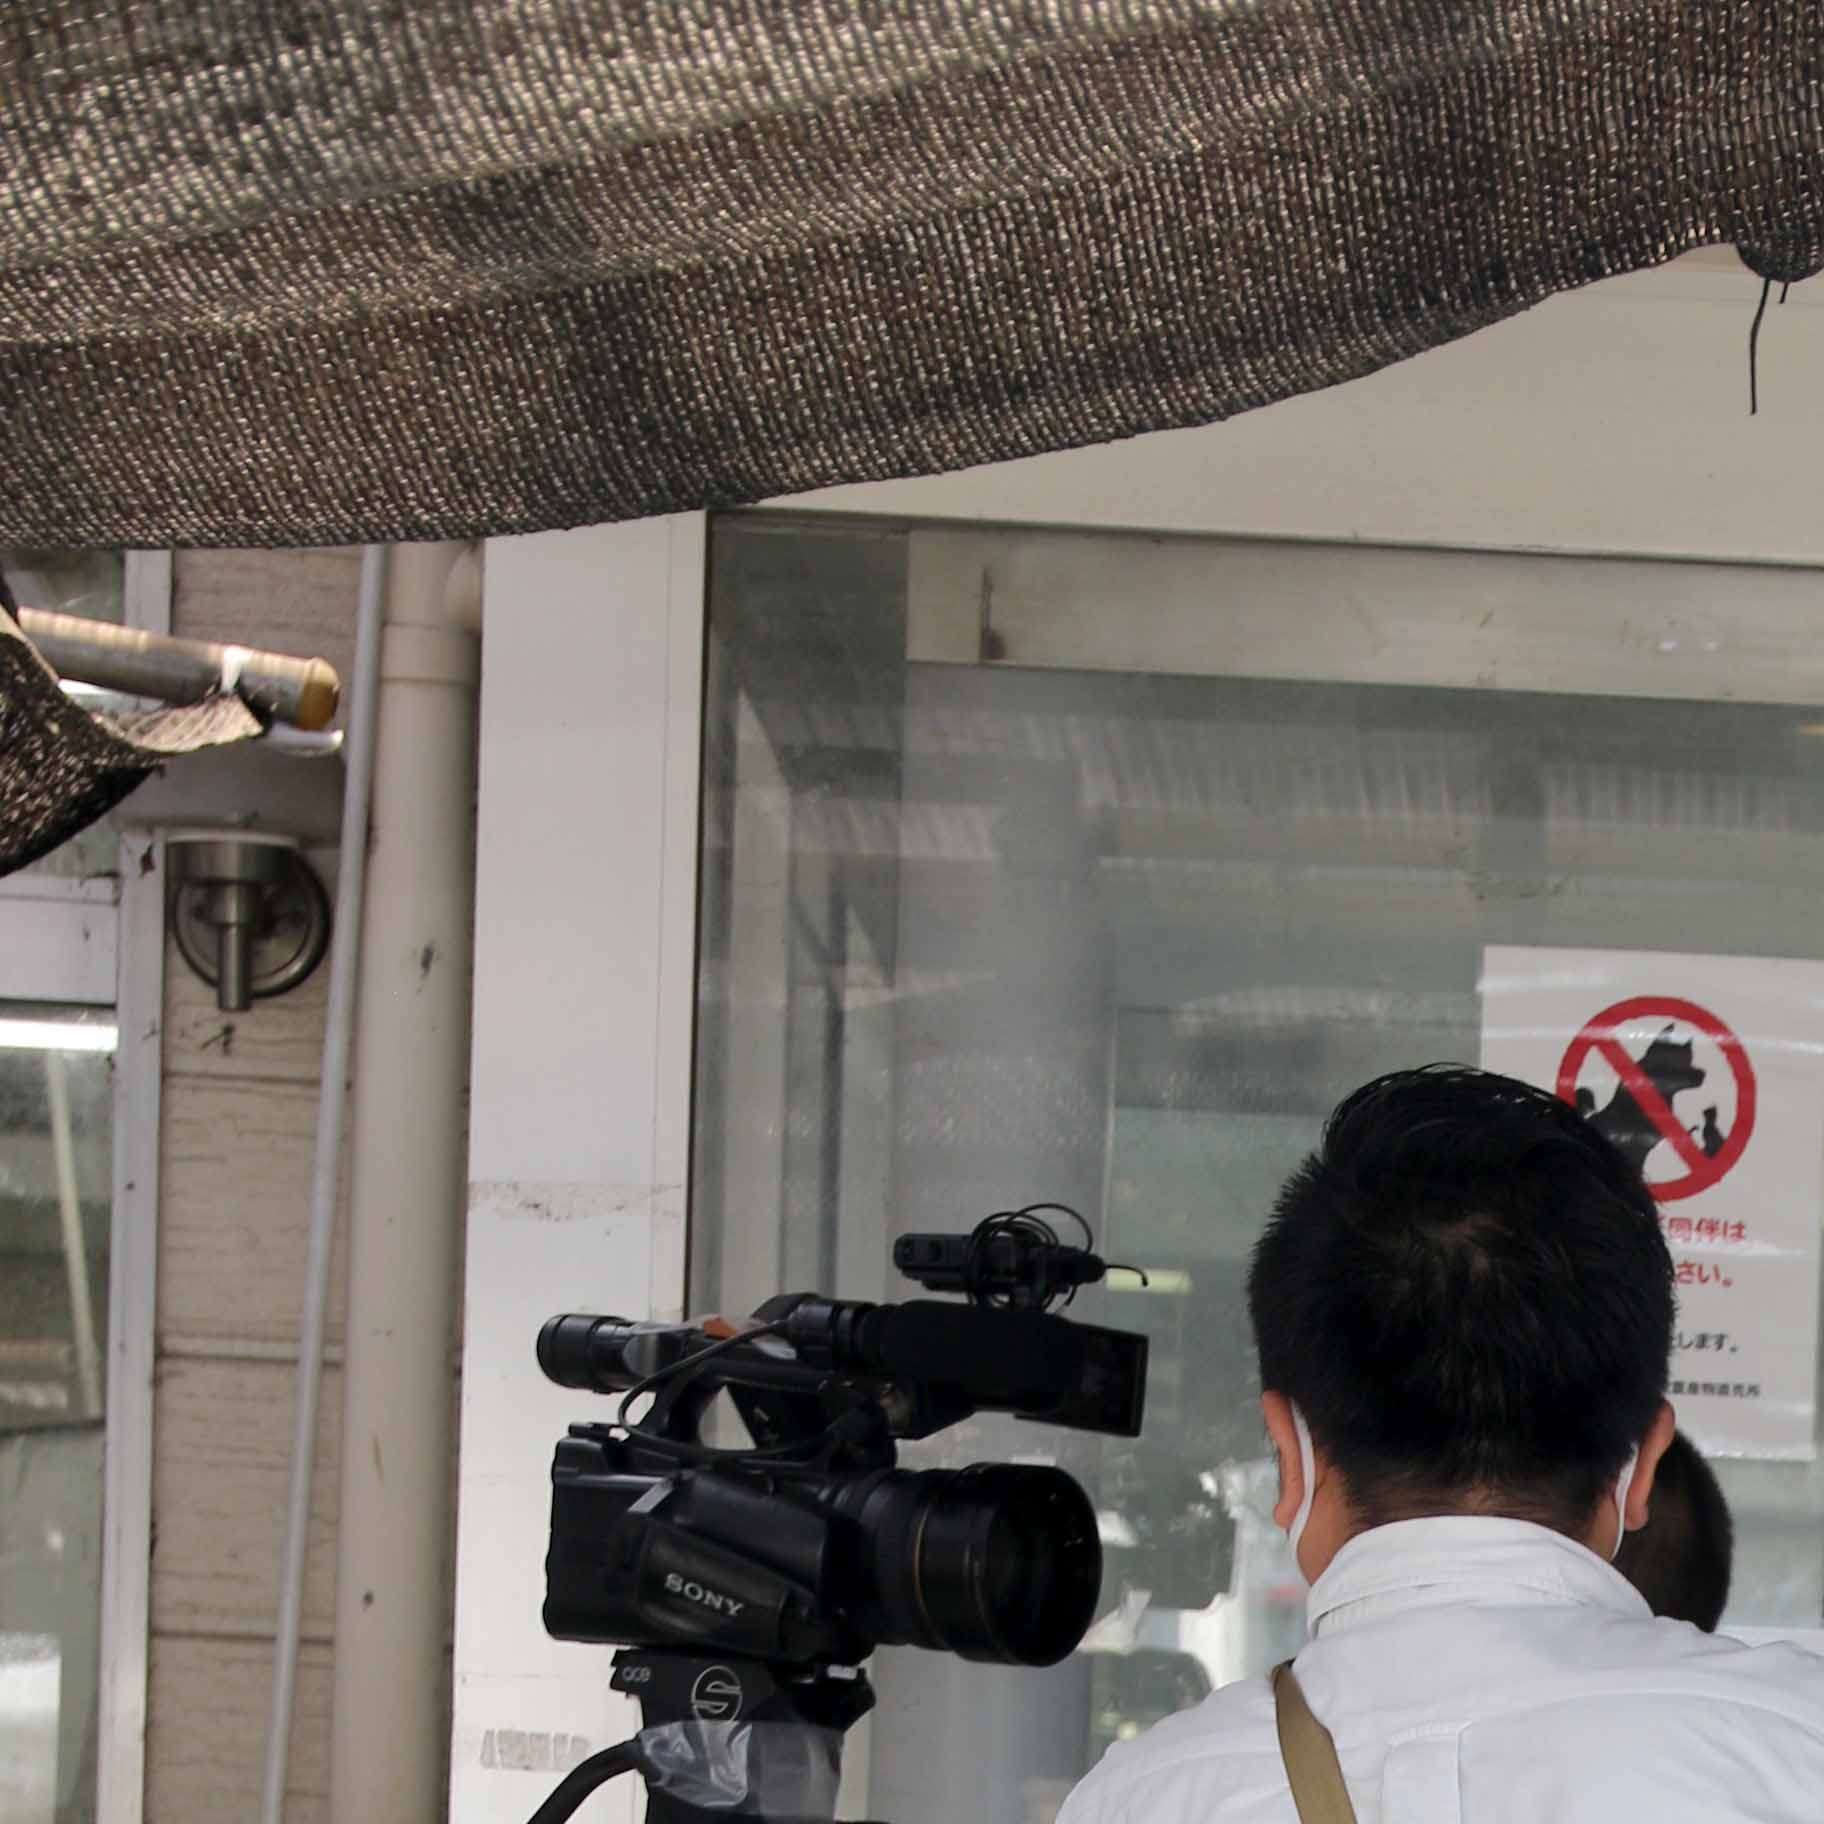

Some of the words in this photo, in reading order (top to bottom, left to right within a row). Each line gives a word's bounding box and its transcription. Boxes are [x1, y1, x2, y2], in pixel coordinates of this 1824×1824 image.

[1659, 1216, 1748, 1243] 同伴は
[664, 1572, 745, 1616] SONY
